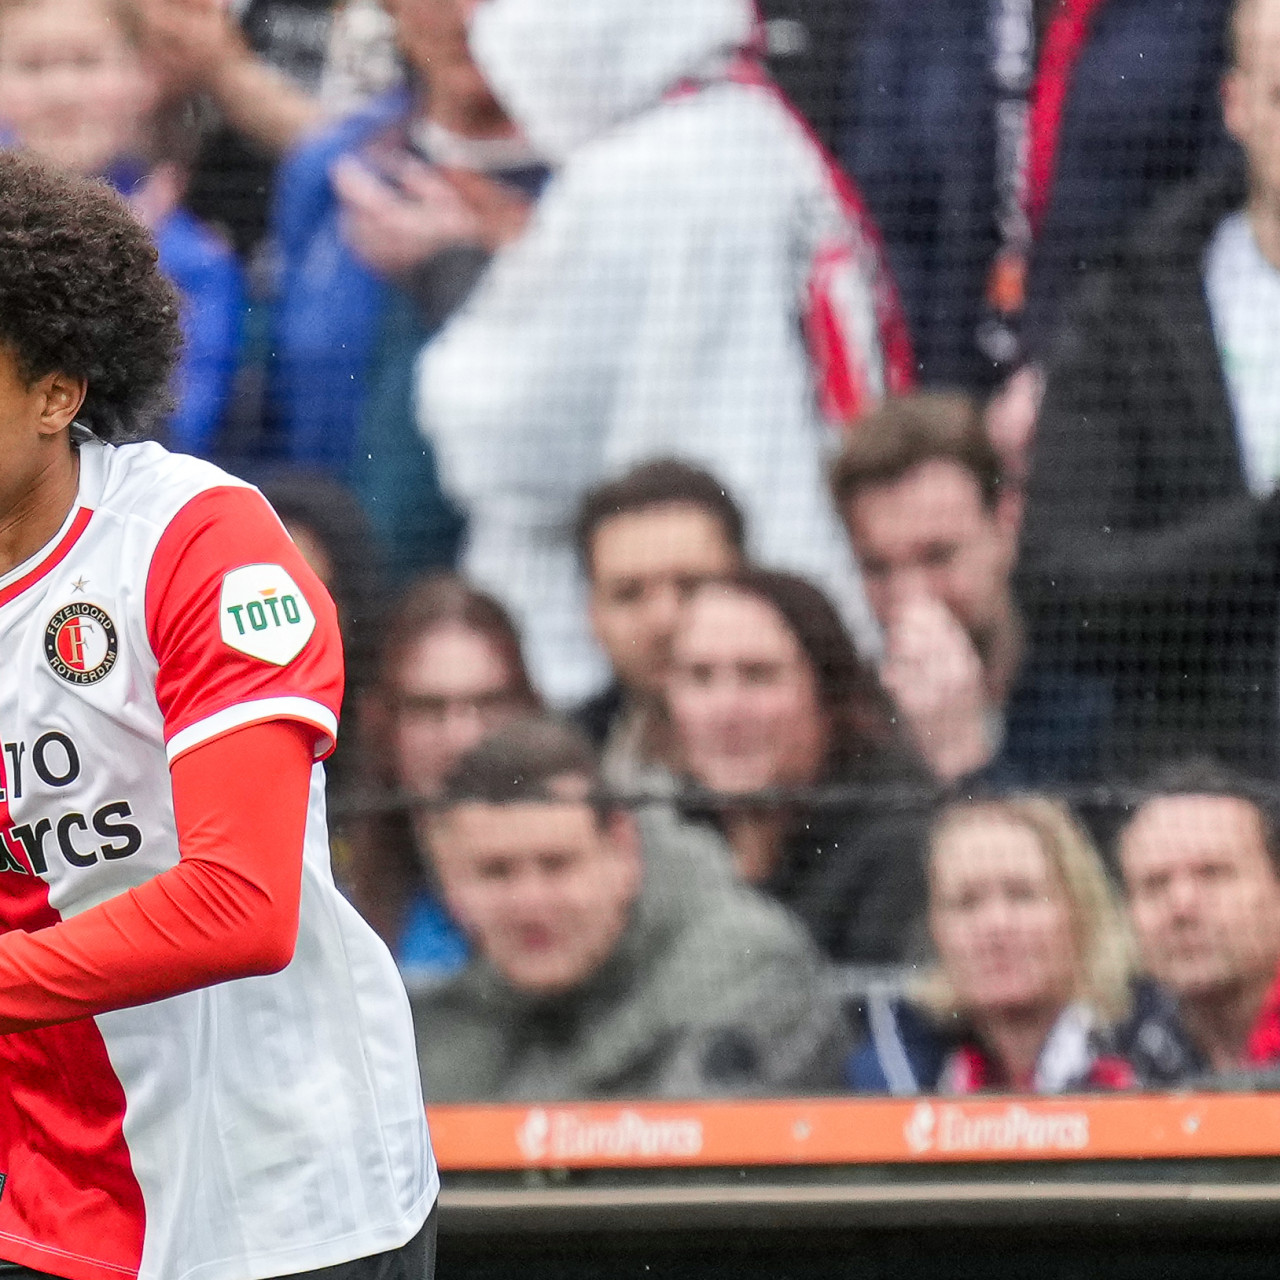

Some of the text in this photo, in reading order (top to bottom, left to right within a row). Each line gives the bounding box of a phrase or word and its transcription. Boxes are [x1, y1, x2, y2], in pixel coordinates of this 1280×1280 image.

[47, 604, 112, 635] FEYENOORD
[227, 594, 301, 635] TOTO
[50, 650, 117, 683] ROTTERDAM
